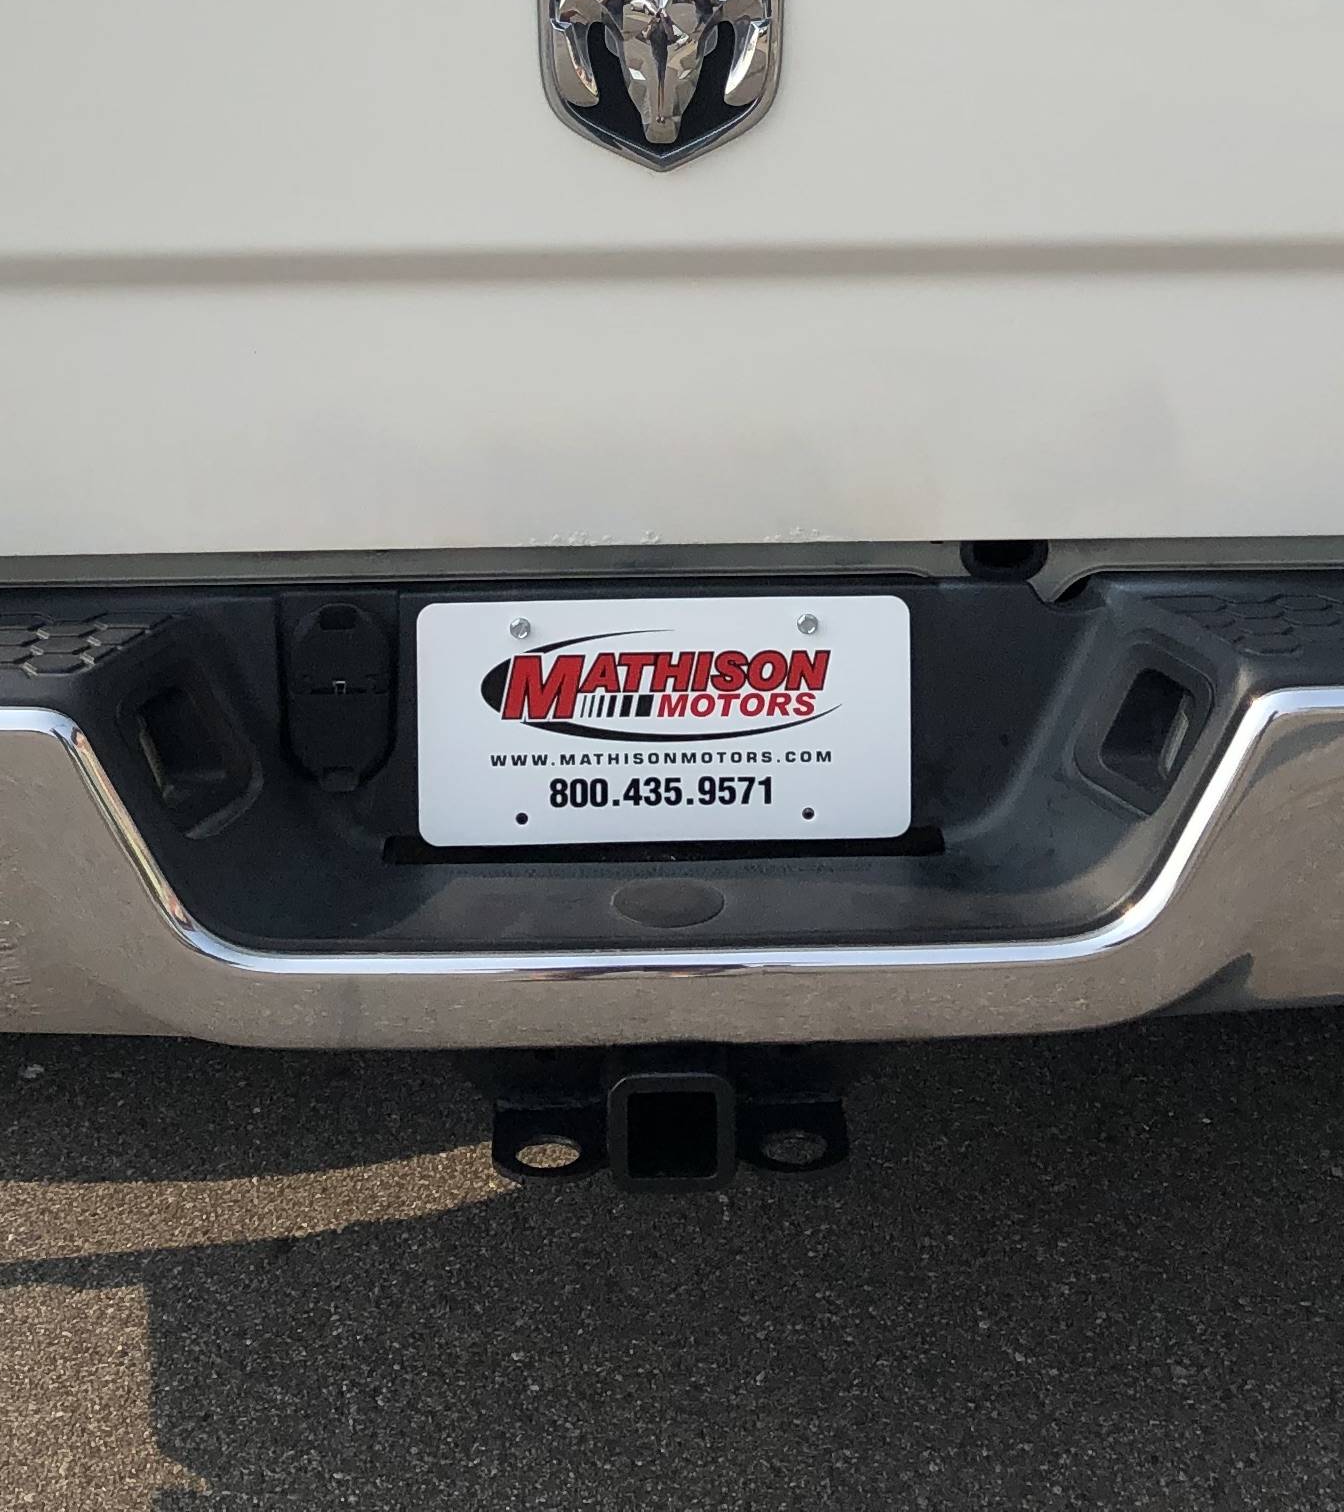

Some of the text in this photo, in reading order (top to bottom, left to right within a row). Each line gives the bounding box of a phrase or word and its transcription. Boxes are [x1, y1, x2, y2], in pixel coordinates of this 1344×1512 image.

[501, 649, 831, 720] MATHISON
[658, 691, 816, 718] MOTORS
[490, 750, 833, 767] WWW.MATHISONMOTORS.COM
[549, 776, 773, 808] 800.435.9571
